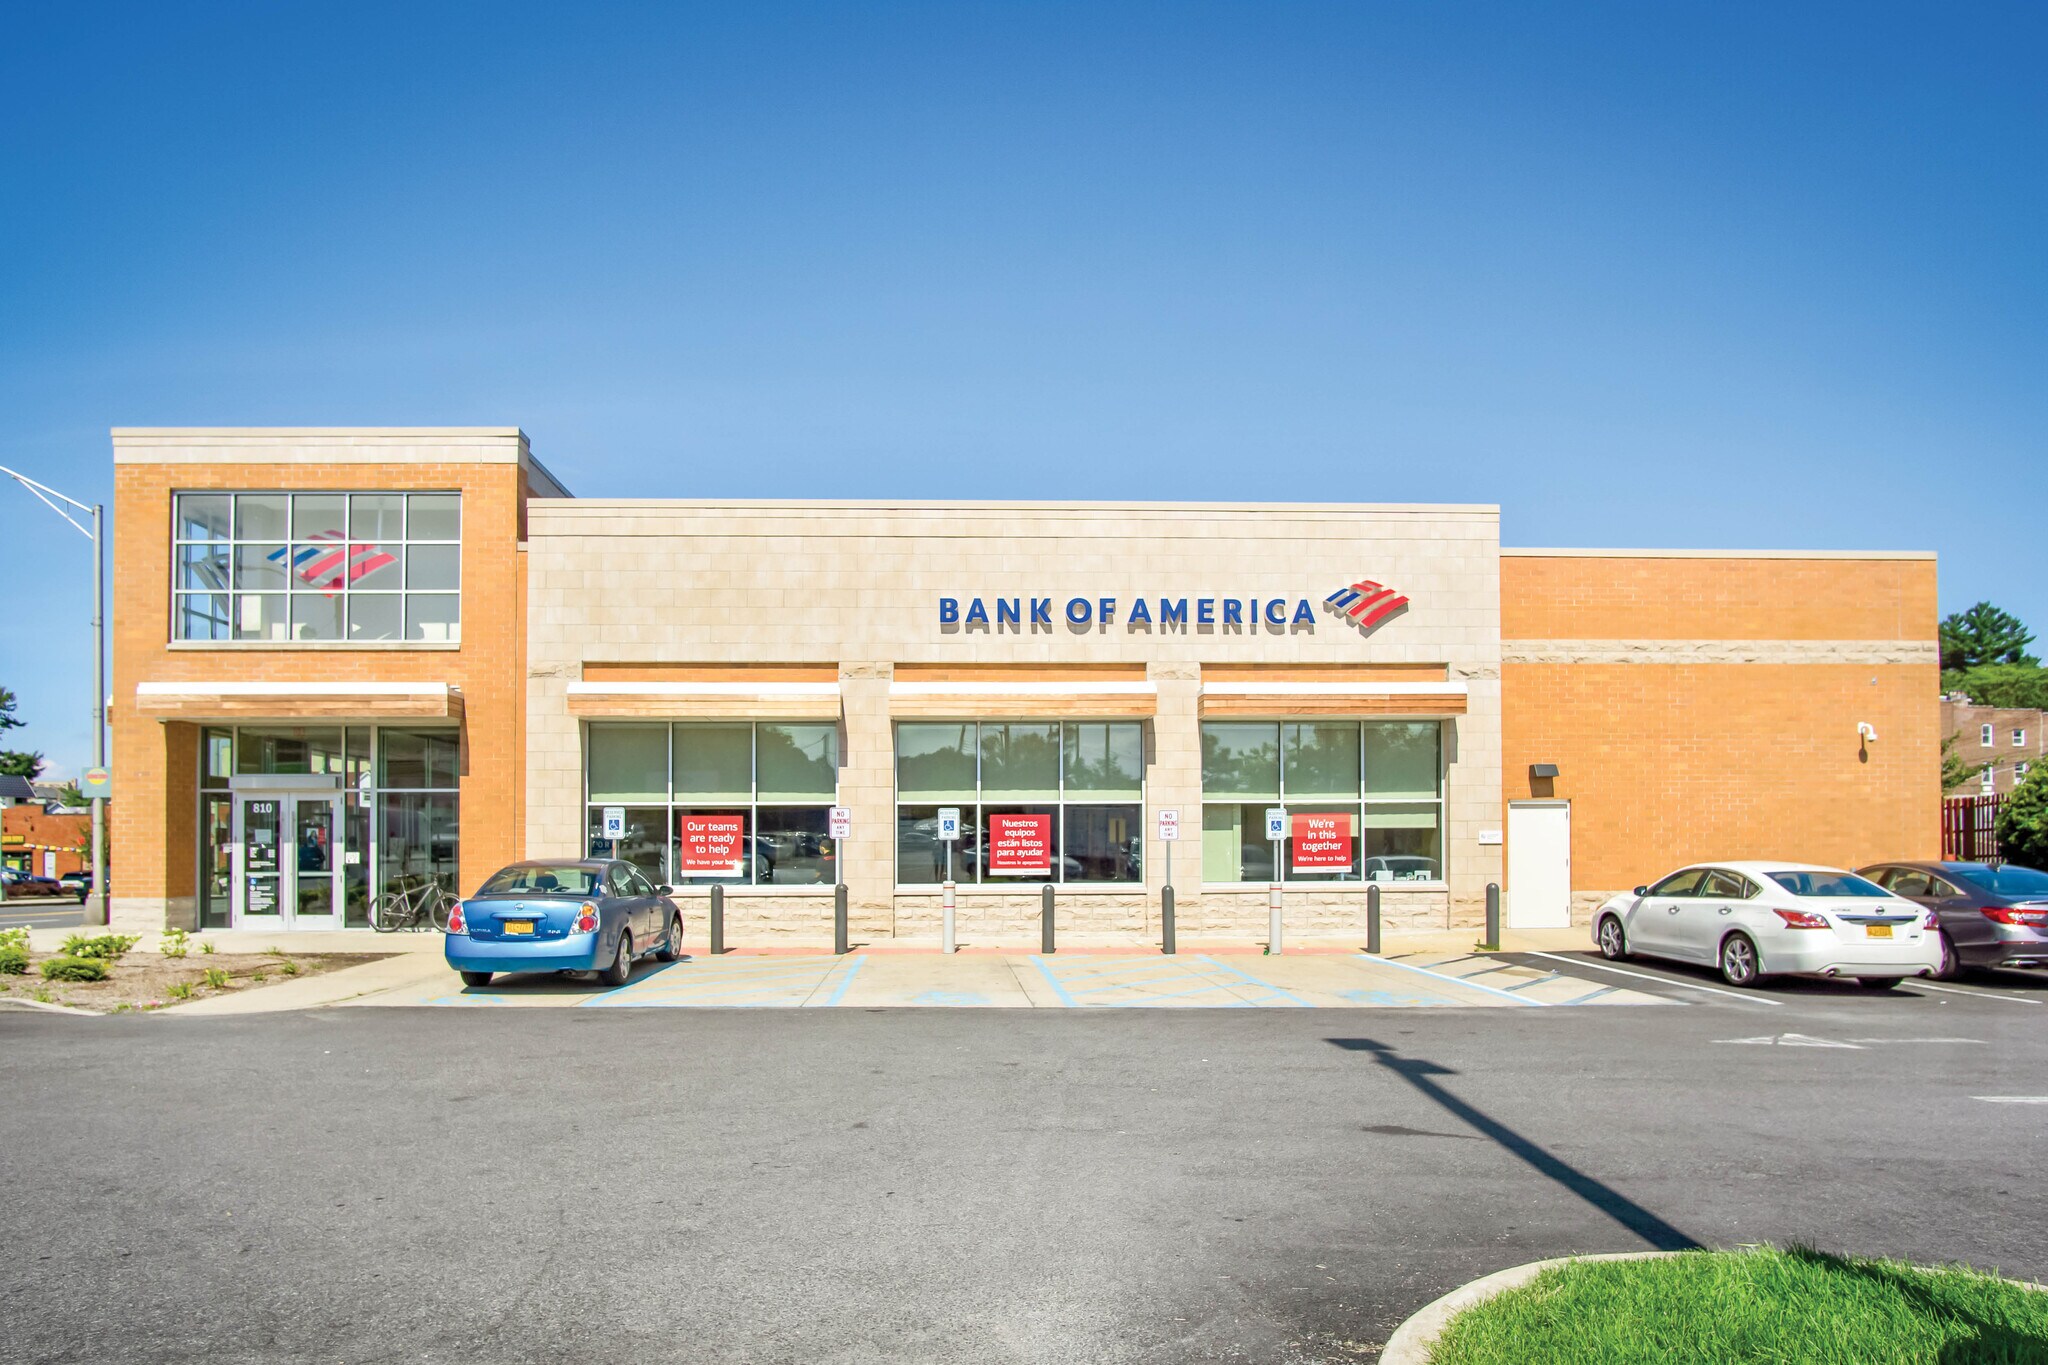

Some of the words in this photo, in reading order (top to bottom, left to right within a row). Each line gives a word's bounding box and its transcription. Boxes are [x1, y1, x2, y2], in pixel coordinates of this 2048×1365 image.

[939, 597, 1052, 624] BANK
[1065, 597, 1116, 624] OF
[1127, 597, 1317, 625] AMERICA
[252, 803, 273, 814] 810
[687, 821, 706, 831] Our
[708, 822, 738, 832] teams
[1002, 819, 1039, 828] Nuestros
[1308, 818, 1335, 829] We're
[690, 834, 706, 843] are
[708, 832, 736, 845] ready
[1004, 828, 1036, 839] equipos
[1318, 829, 1337, 840] this
[997, 838, 1020, 848] están
[1021, 839, 1043, 847] listos
[1301, 840, 1343, 853] together
[695, 845, 706, 854] to
[708, 844, 730, 856] help
[996, 849, 1015, 858] para
[1016, 847, 1044, 859] ayudar
[711, 859, 724, 867] your
[1334, 855, 1347, 863] help
